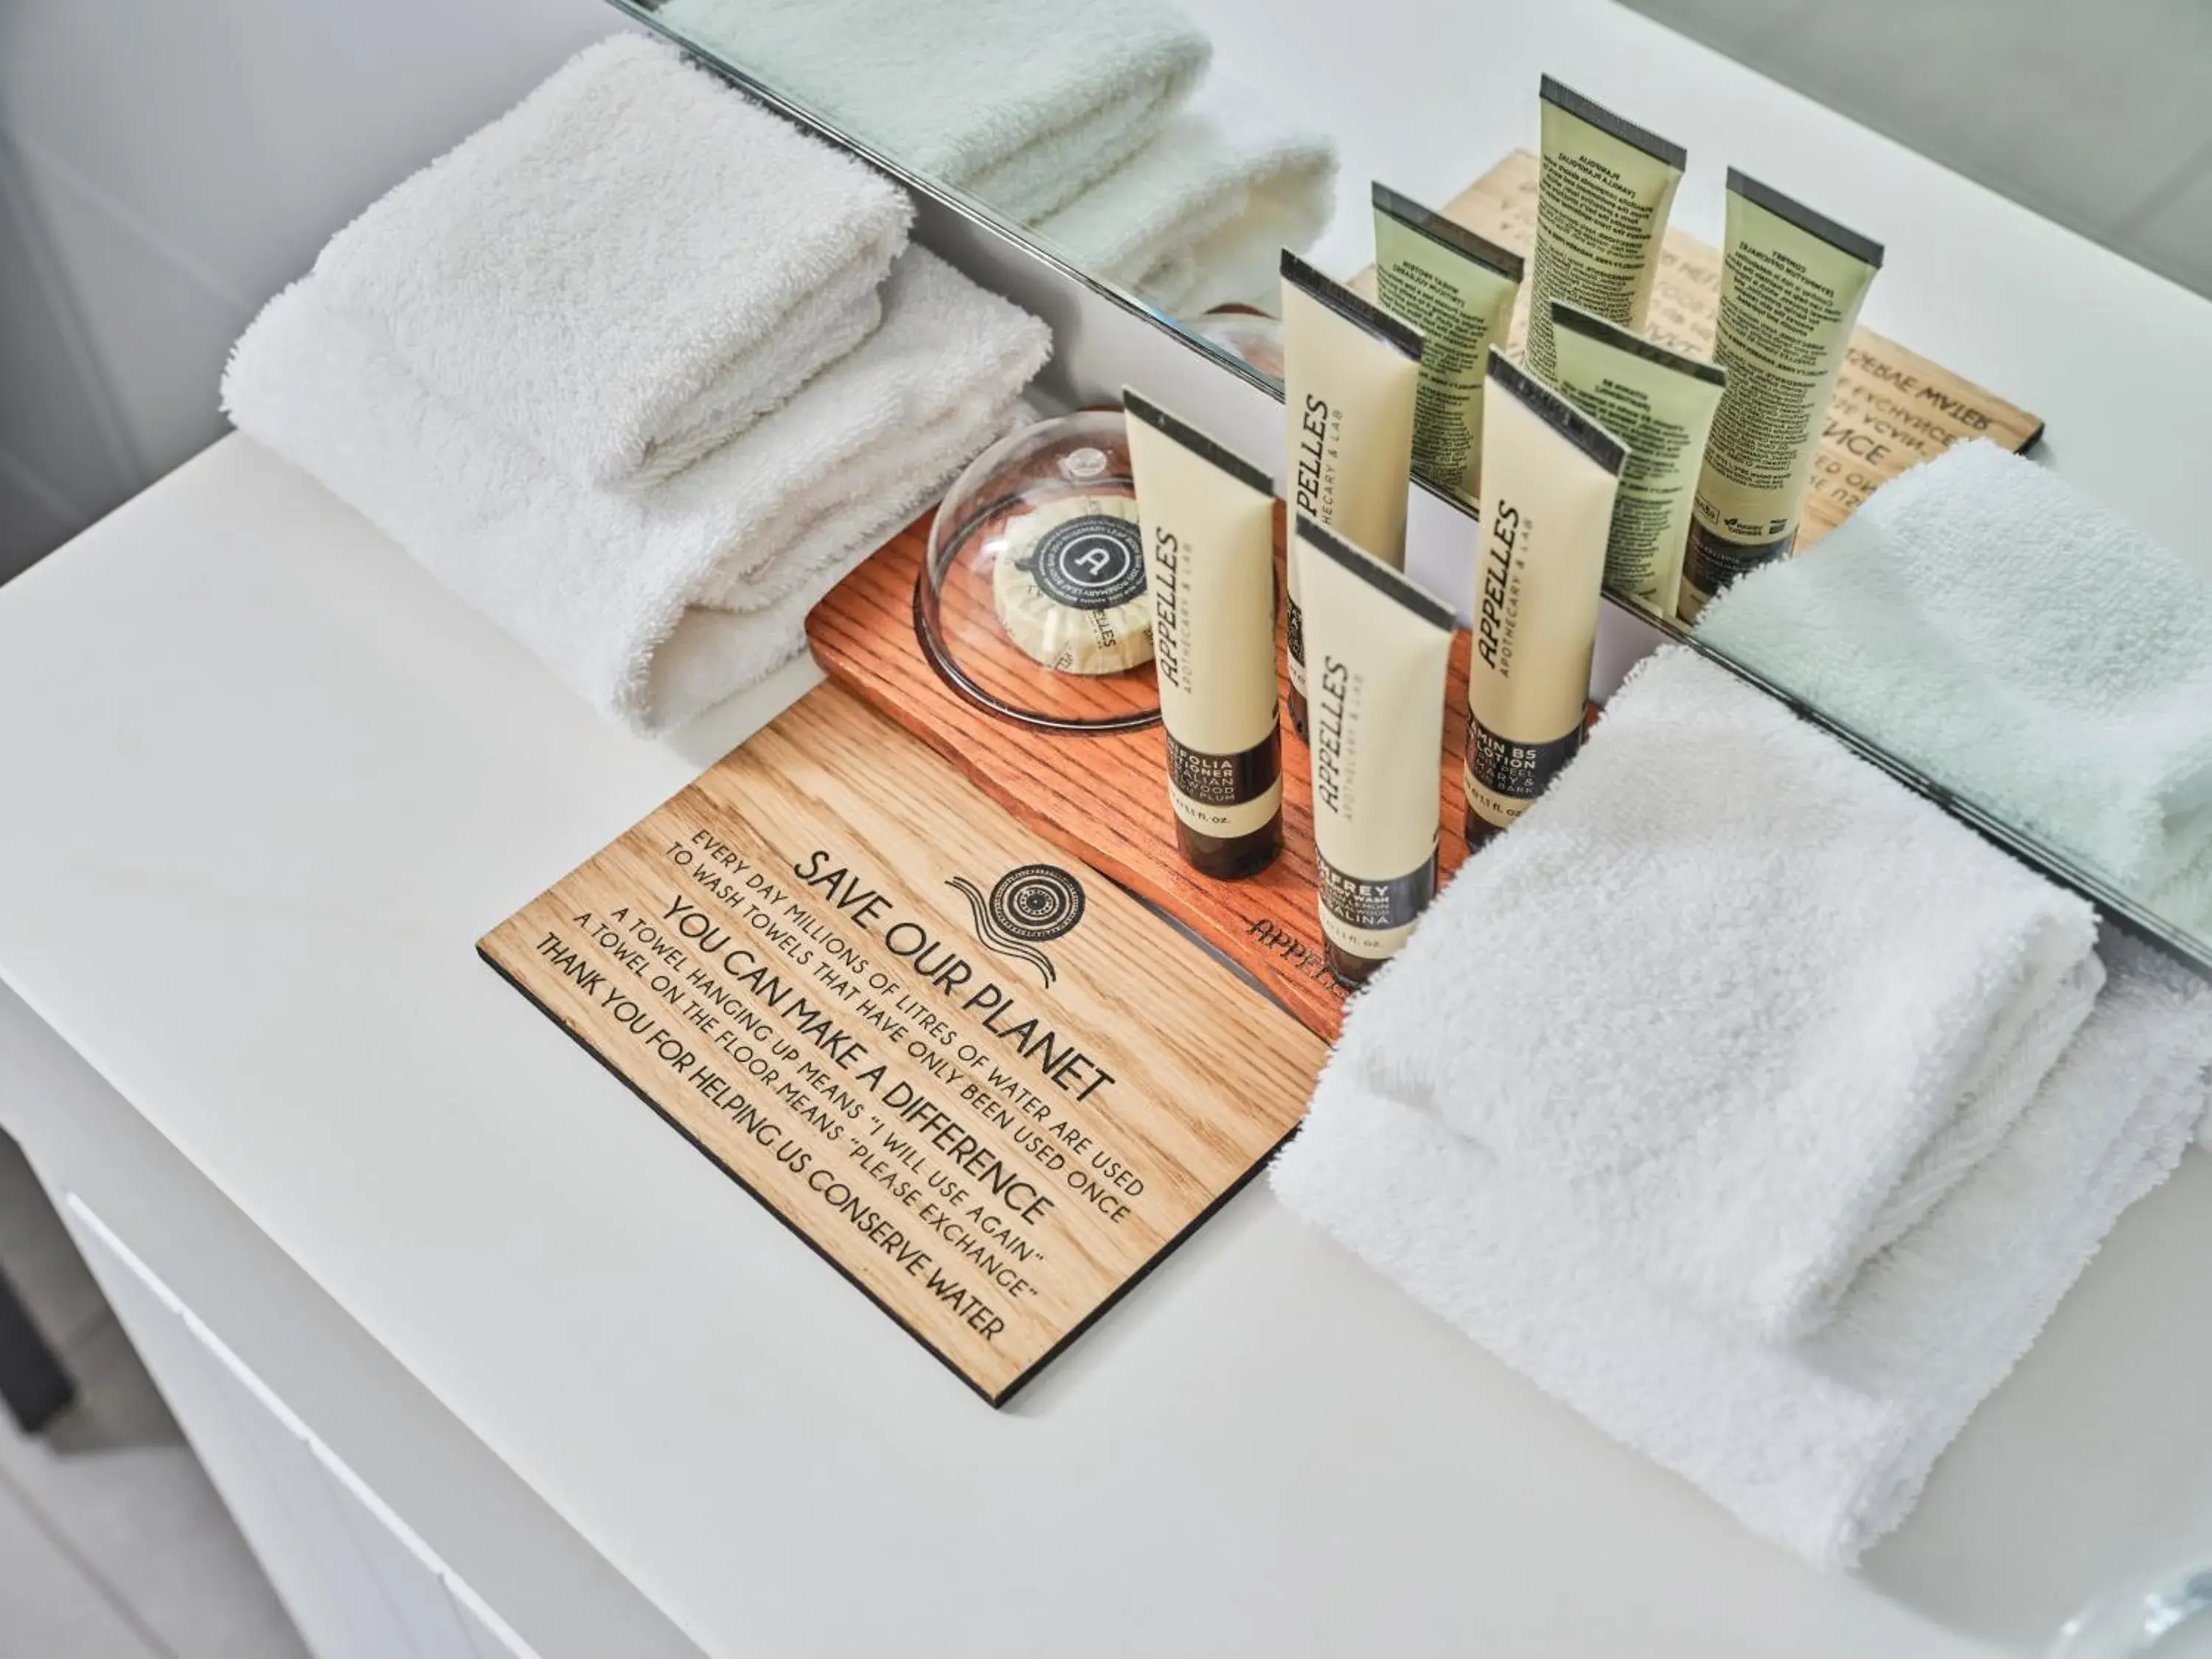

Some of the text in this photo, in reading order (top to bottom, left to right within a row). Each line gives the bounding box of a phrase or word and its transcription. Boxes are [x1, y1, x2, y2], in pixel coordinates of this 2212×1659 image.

[1296, 393, 1328, 516] PELLES
[1321, 464, 1335, 525] HECARY
[1331, 409, 1343, 442] LAB
[1074, 548, 1110, 576] A
[1092, 608, 1116, 647] ELLES
[1155, 526, 1178, 687] APPELLES
[1478, 498, 1519, 669] APPELLES
[1499, 575, 1521, 678] APOTHECARY
[1318, 655, 1349, 814] APPELLES
[1477, 740, 1536, 769] LOTION
[1512, 748, 1537, 760] B5
[572, 912, 591, 928] A
[591, 922, 650, 978] TOWEL
[650, 975, 685, 1004] ON
[682, 1000, 720, 1034] THE
[714, 1029, 779, 1086] FLOOR
[775, 1082, 844, 1140] MEANS
[666, 841, 1130, 1223] TO WASH TOWELS THAT HAVE ONLY BEEN USED ONCE
[691, 829, 1144, 1196] EVERY DAY MILLIONS OF LITRES OF WATER ARE USED
[793, 849, 1116, 1102] SAVE OUR PLANET
[535, 931, 1004, 1340] THANK YOU FOR HELPING US CONSERVE WATER
[611, 907, 629, 922] A
[628, 917, 687, 972] TOWEL
[685, 967, 773, 1042] HANGING
[771, 1038, 799, 1061] UP
[796, 1060, 863, 1119] MEANS
[883, 1131, 925, 1174] WILL
[928, 1169, 969, 1206] USE
[662, 894, 1054, 1225] YOU CAN MAKE A DIFFERENCE
